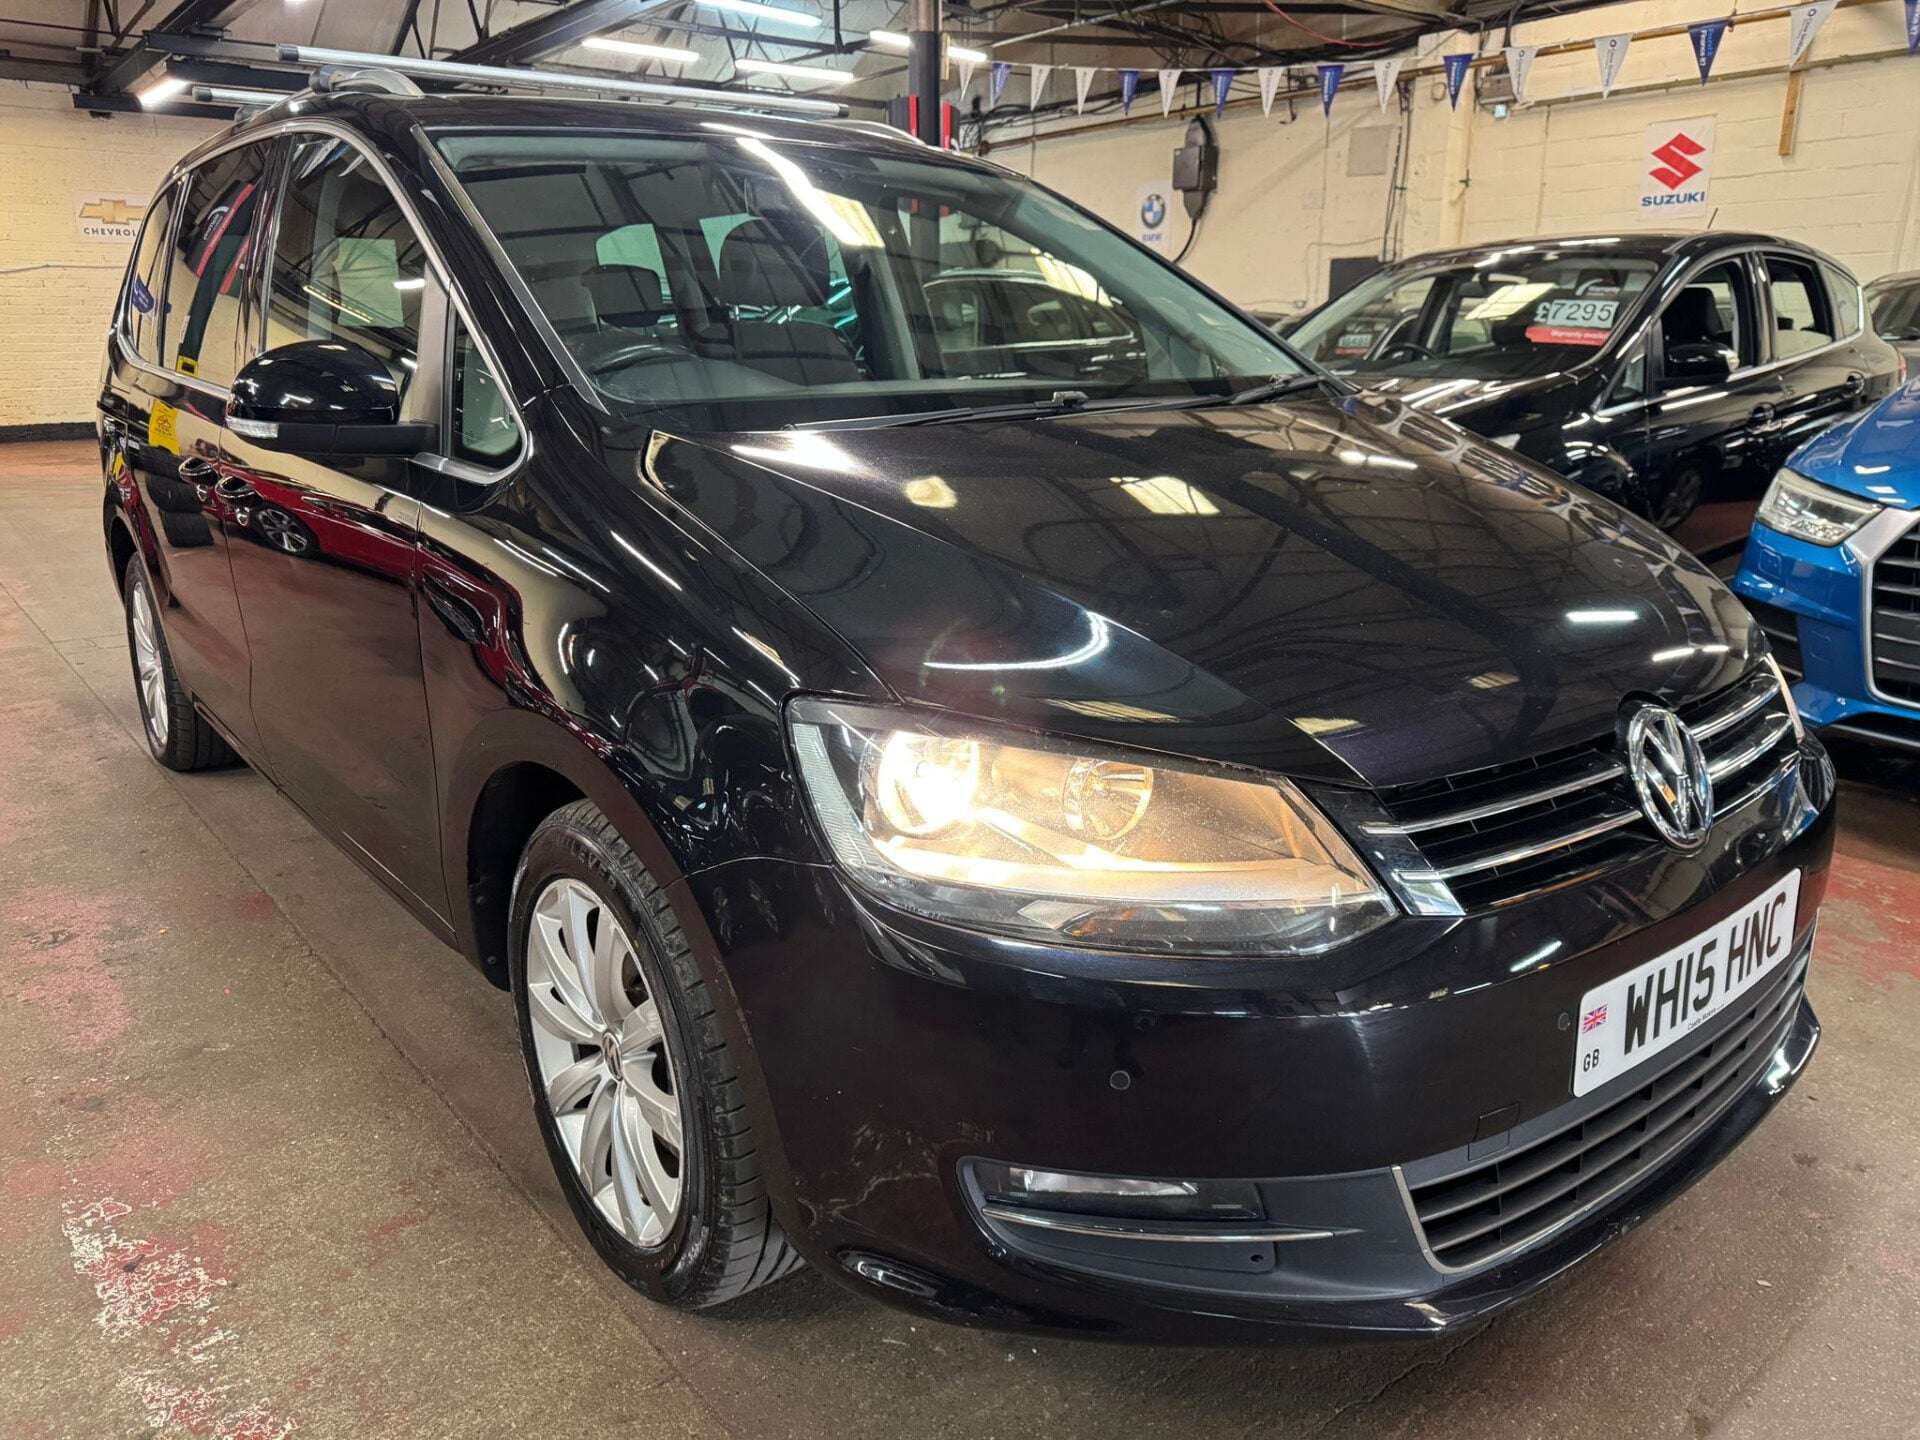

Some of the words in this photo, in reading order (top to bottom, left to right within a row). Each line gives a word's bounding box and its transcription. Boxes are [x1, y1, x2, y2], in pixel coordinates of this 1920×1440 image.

[1641, 191, 1705, 207] SUZUKI
[83, 227, 138, 237] CHEVROL
[1534, 302, 1615, 322] £7295
[1624, 938, 1718, 1056] WH15
[1725, 891, 1786, 993] HNC
[1583, 1049, 1600, 1072] GB
